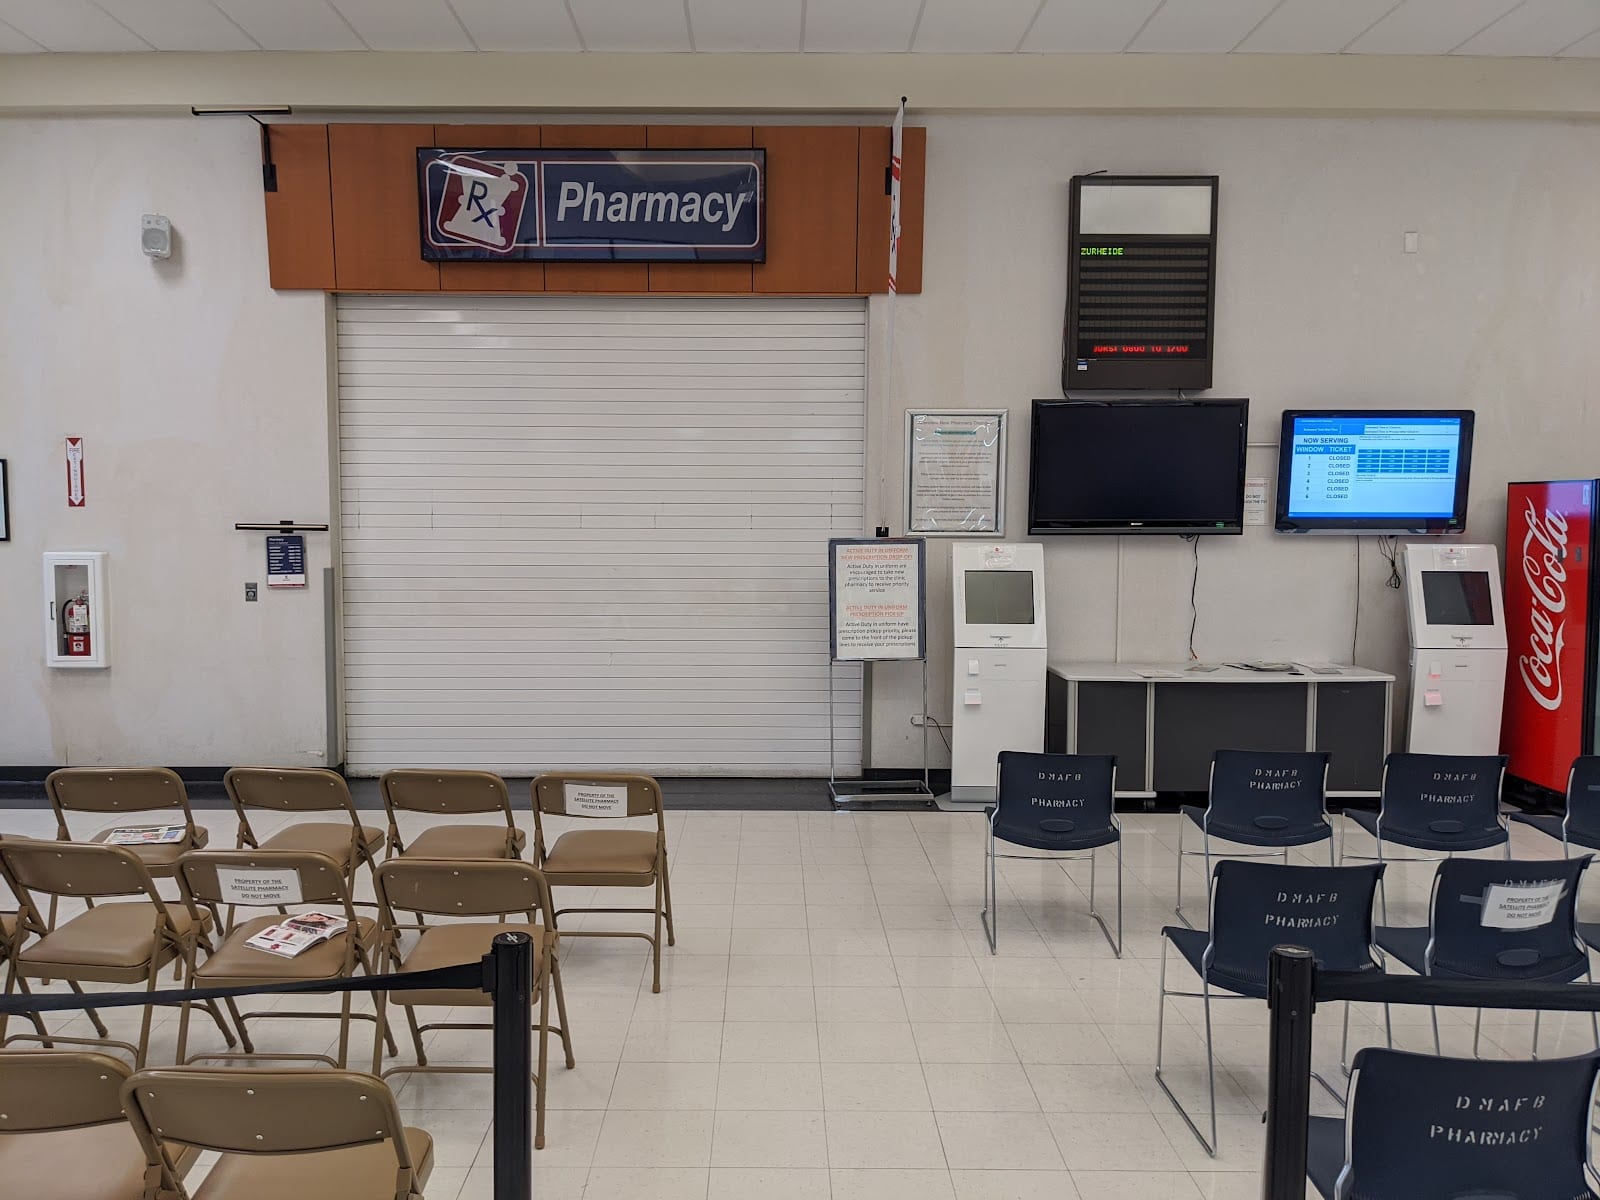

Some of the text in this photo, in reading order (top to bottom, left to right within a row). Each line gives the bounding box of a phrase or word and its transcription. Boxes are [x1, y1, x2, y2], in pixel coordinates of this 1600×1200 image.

[466, 180, 498, 228] Rx
[557, 180, 747, 232] Pharmacy
[1080, 247, 1124, 255] ZURHEIDE
[1519, 496, 1568, 711] Coca-Cola
[1250, 780, 1302, 790] PHARMACY
[1031, 797, 1085, 808] PHARMACY
[1420, 793, 1476, 804] PHARMACY
[1265, 914, 1340, 928] PHARMACY
[1430, 1124, 1543, 1145] PHARMACY
